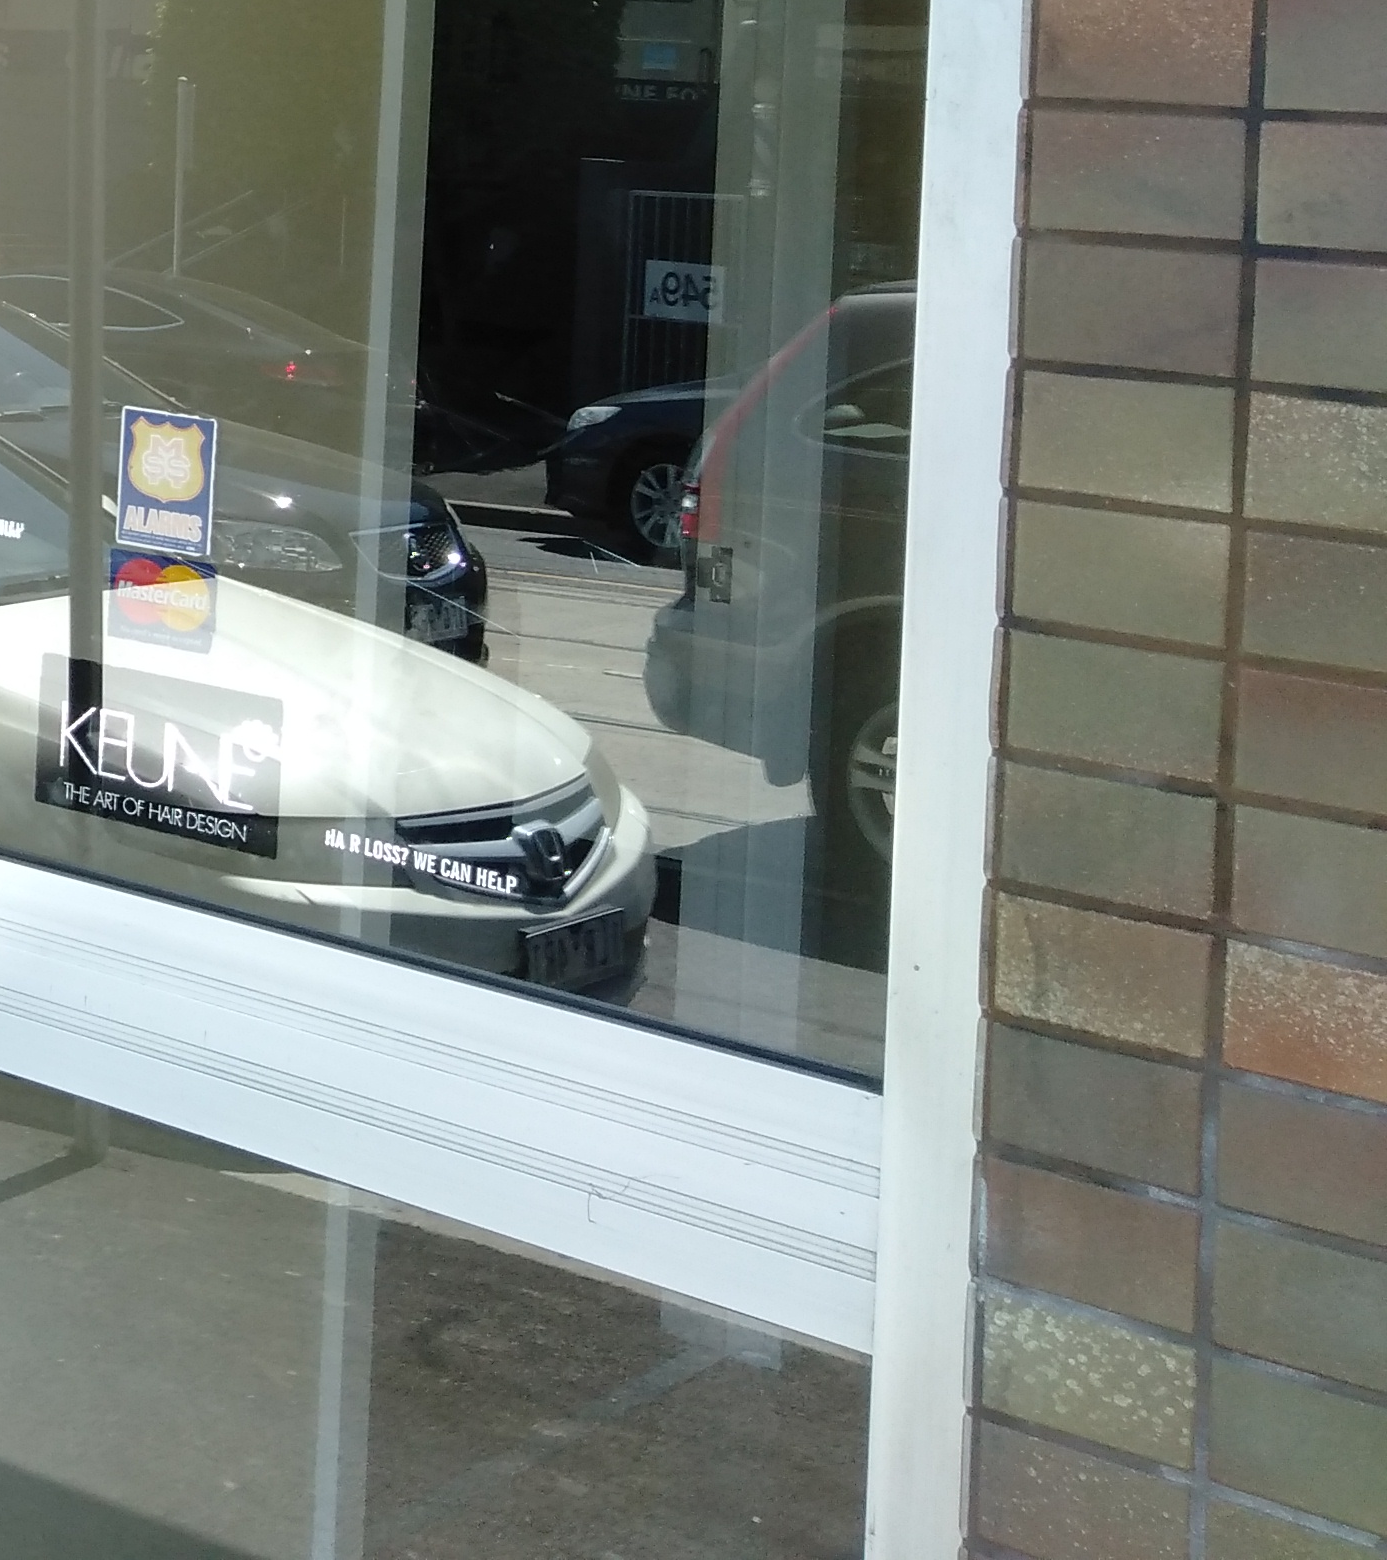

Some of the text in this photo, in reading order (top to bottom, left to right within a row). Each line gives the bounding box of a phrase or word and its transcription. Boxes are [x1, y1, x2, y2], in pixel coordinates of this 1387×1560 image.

[123, 505, 203, 543] ALARMS
[116, 579, 208, 611] MasterCard
[59, 700, 257, 812] KEUNE
[63, 781, 247, 843] THE ART OF HAIR DESIGN
[364, 836, 410, 866] LOSS?
[413, 849, 437, 874] WE
[440, 856, 472, 884] CAN
[476, 866, 517, 894] HELP
